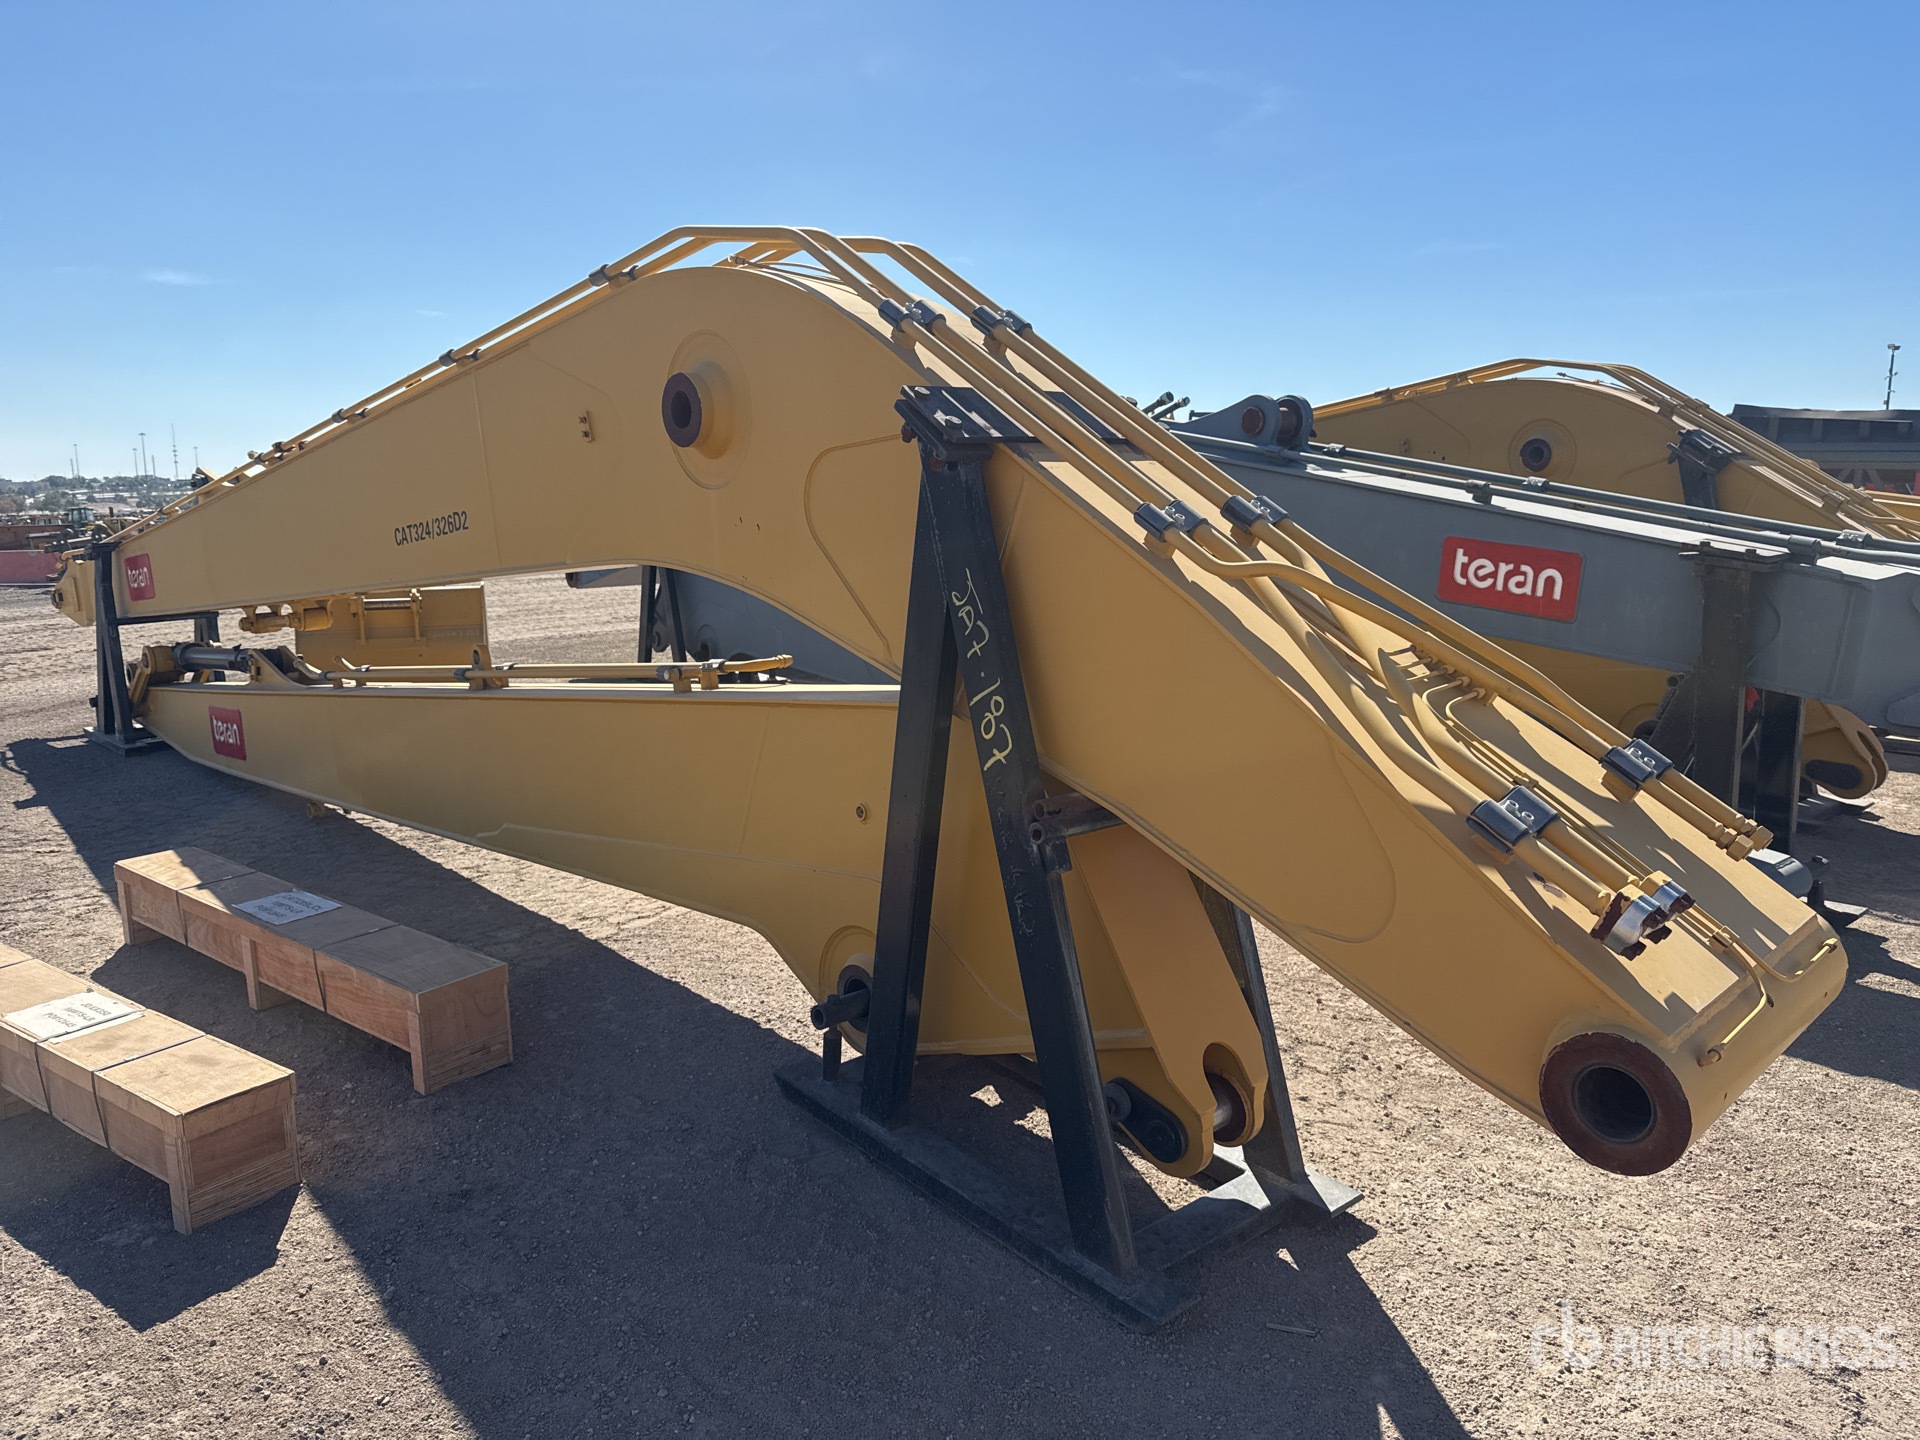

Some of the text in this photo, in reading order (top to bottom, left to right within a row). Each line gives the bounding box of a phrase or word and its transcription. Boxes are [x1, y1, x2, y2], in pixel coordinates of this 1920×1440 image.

[394, 510, 469, 546] CAT324/326D2
[127, 566, 150, 588] teran
[1453, 548, 1563, 601] teran
[212, 715, 240, 746] teran
